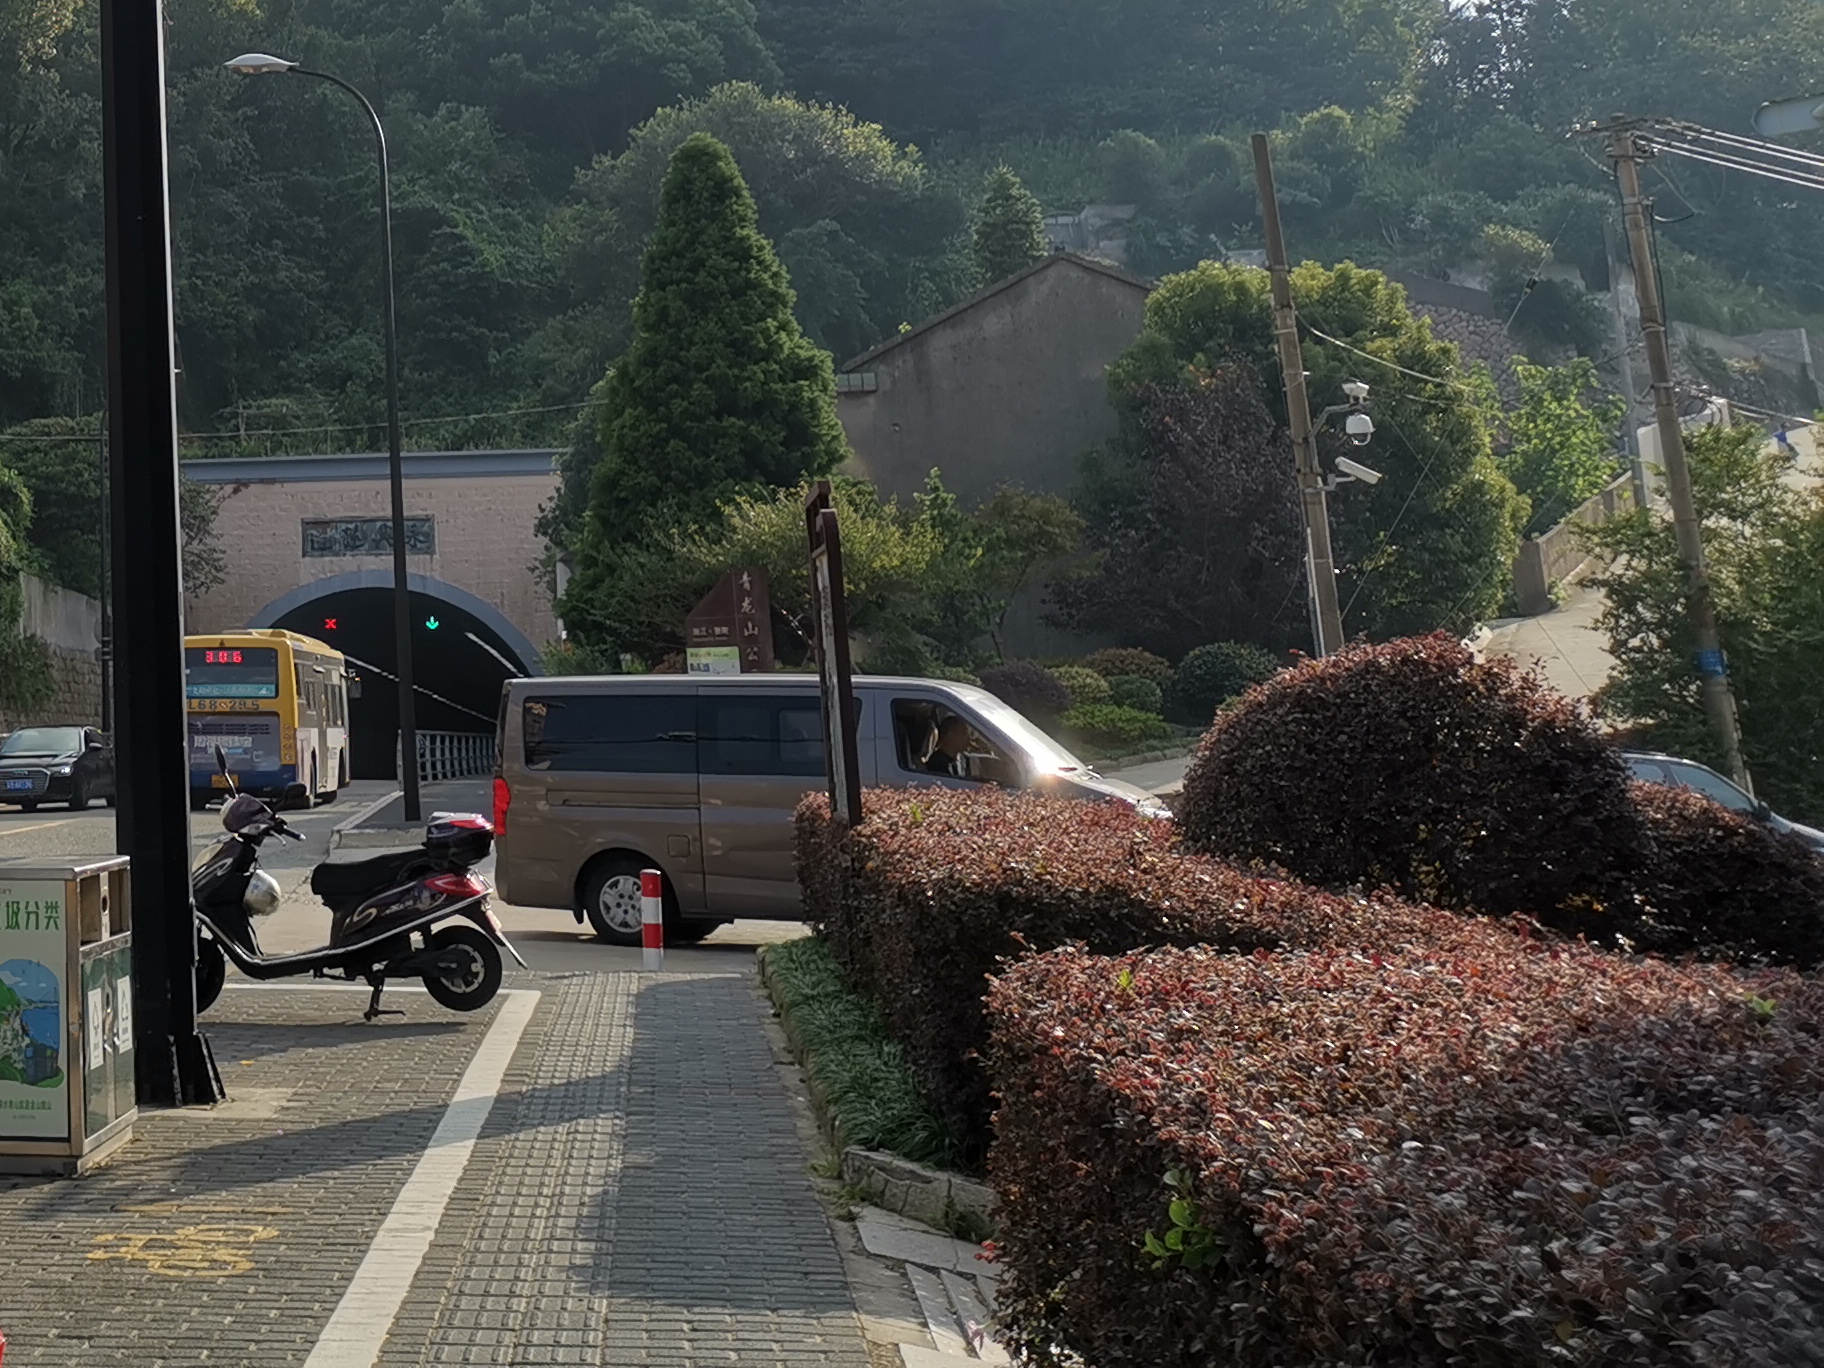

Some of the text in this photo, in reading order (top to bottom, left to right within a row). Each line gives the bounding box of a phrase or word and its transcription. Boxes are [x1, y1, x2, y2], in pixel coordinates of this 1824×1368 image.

[737, 570, 760, 672] 青龙山公
[205, 650, 243, 664] 306
